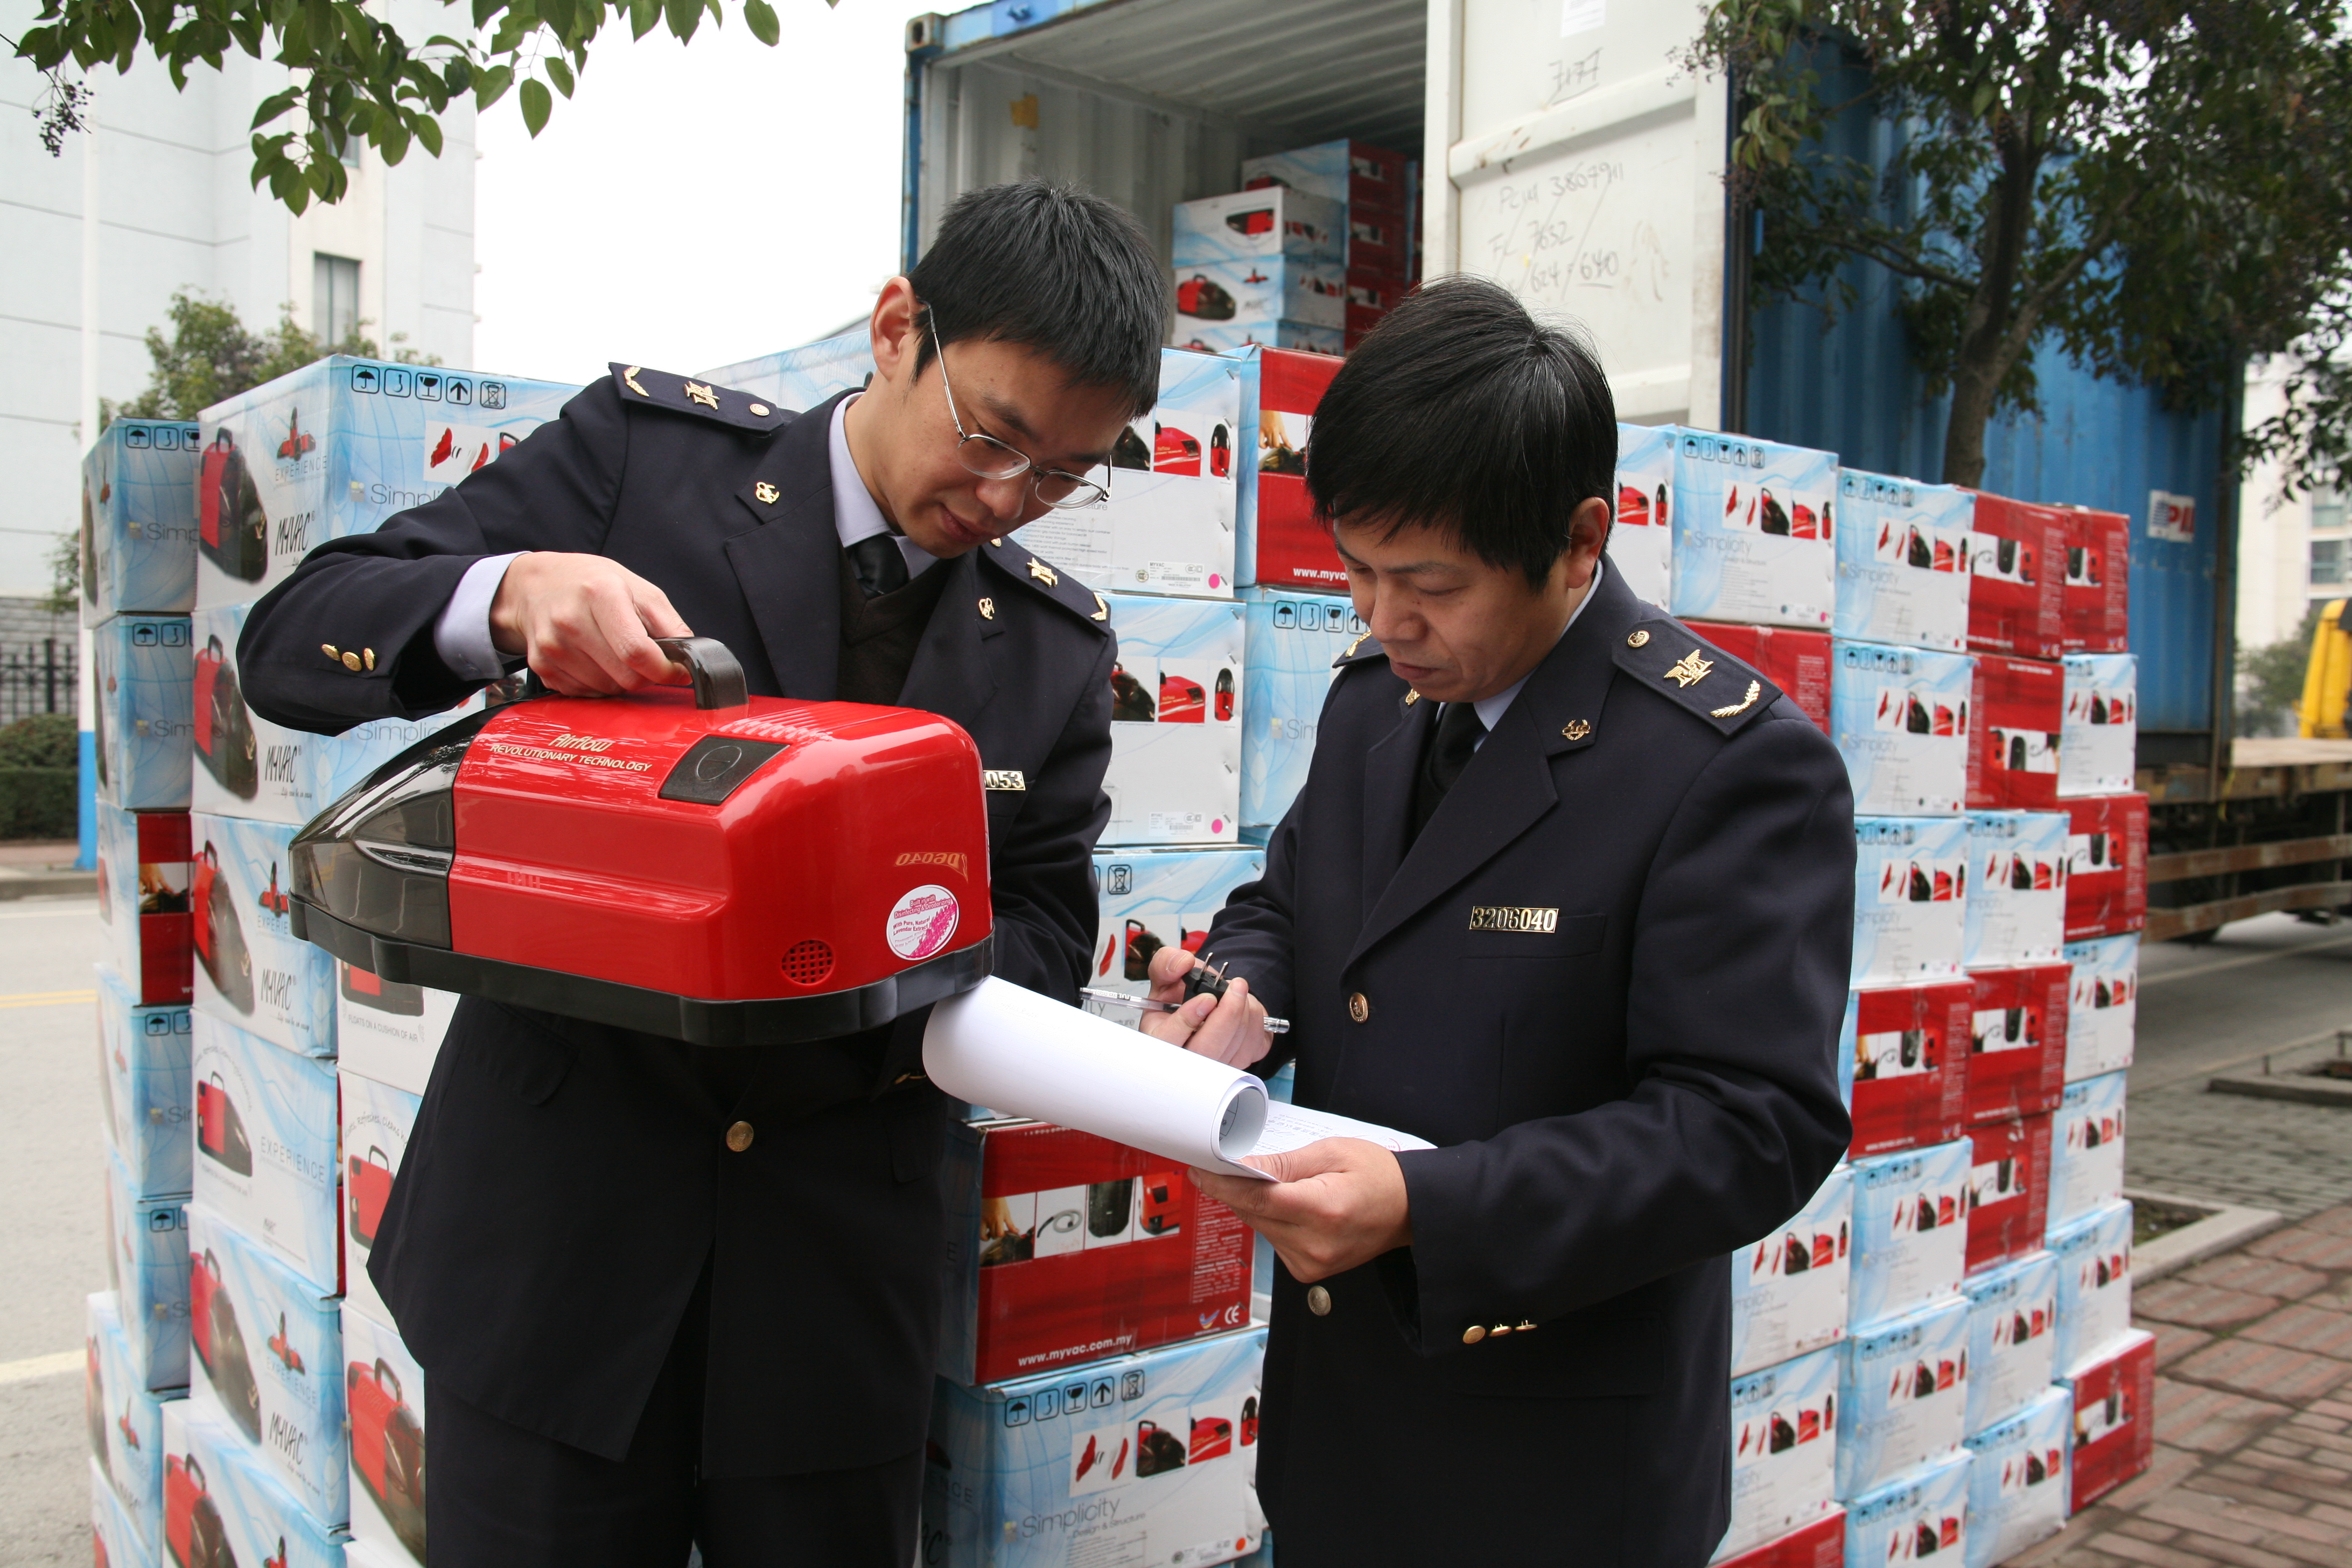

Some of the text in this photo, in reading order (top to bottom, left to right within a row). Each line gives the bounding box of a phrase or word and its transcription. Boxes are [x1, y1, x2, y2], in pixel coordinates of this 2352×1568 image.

[275, 456, 327, 482] EXPERIENCE
[370, 483, 440, 506] Simpl
[1695, 531, 1752, 558] Simplicity
[357, 722, 451, 746] Simplic
[548, 733, 618, 752] Airflow
[489, 744, 653, 773] REVOLUTIONARY TECHNOLOGY
[984, 771, 1024, 789] 053
[894, 907, 920, 919] Disinfecting
[926, 898, 951, 910] Deodorizing
[1472, 908, 1557, 931] 3206040
[258, 915, 289, 935] EXPERIE
[348, 1014, 418, 1042] FLOATS ON A CUSHION OF AIR
[261, 1136, 325, 1184] EXPERIENCE
[1018, 1334, 1132, 1366] www.myvac.com.my
[1022, 1497, 1120, 1538] Simplicity
